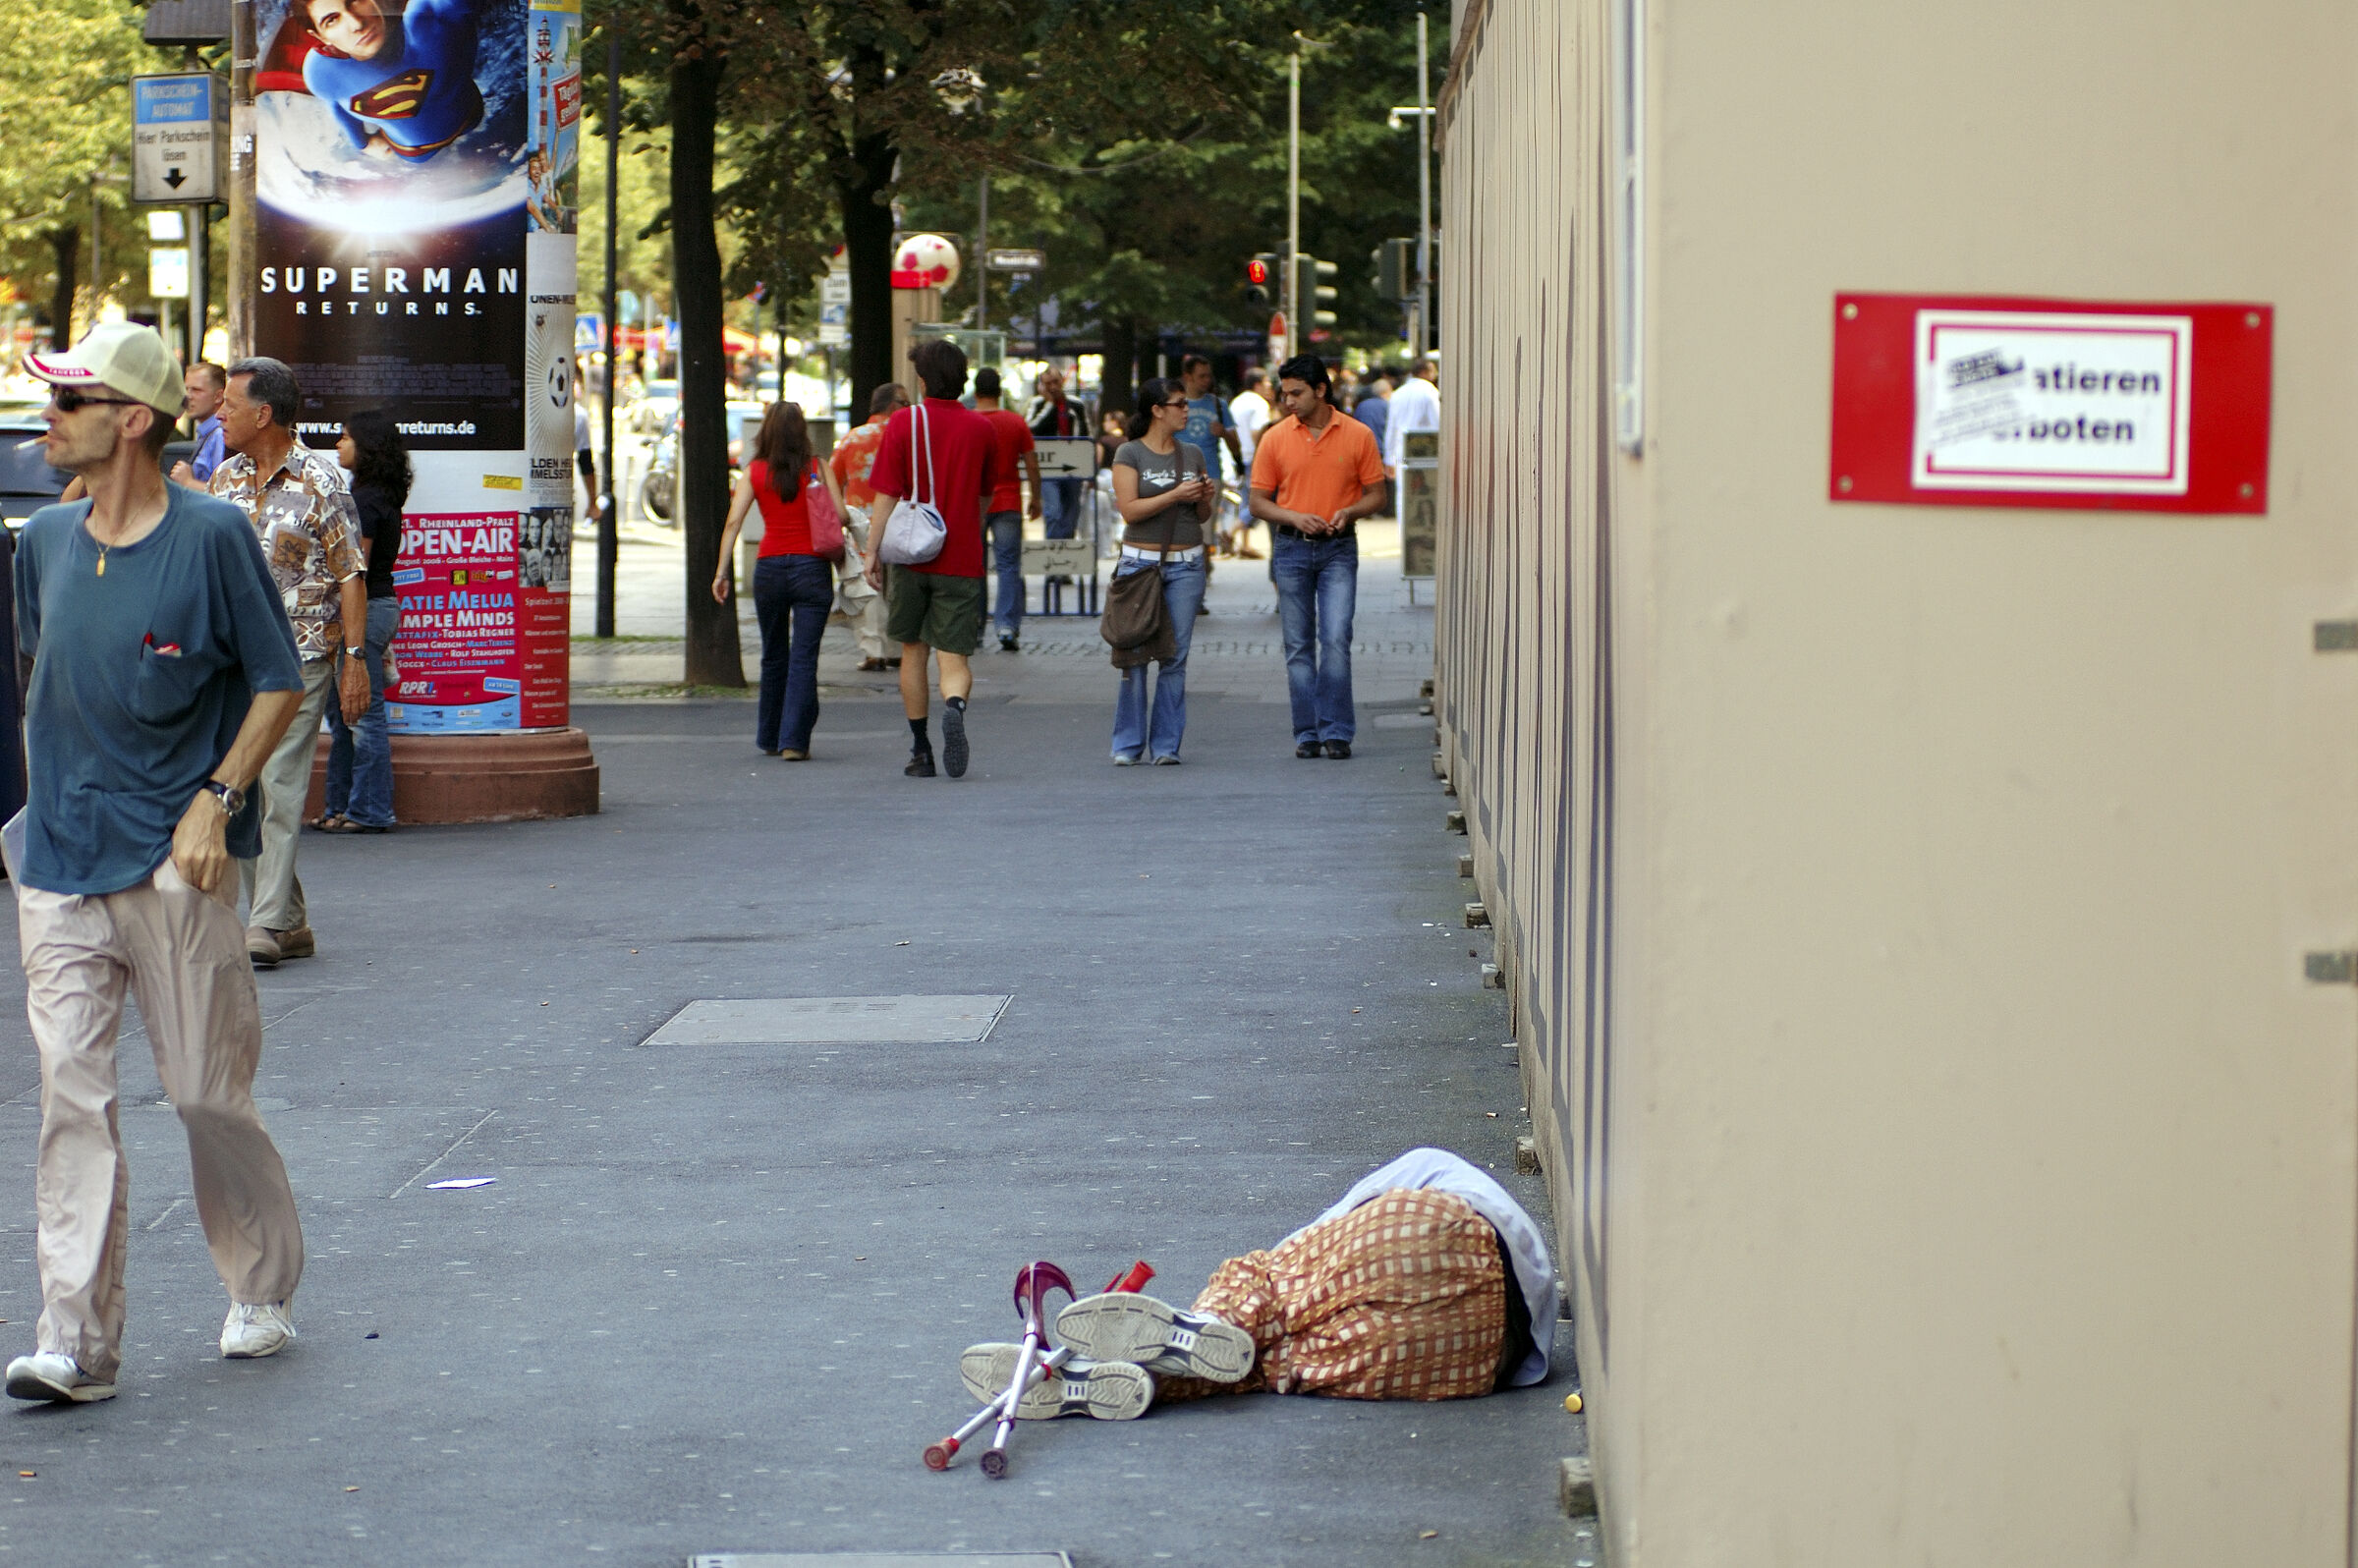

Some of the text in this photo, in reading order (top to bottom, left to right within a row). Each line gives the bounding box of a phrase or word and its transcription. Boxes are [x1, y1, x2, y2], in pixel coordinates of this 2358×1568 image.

[260, 266, 518, 294] SUPERMAN
[296, 302, 477, 315] RETURNS
[295, 420, 477, 435] www.snreturns.de
[400, 594, 444, 610] ATIE
[398, 614, 454, 628] MPLE
[395, 631, 439, 640] ATTAFIX
